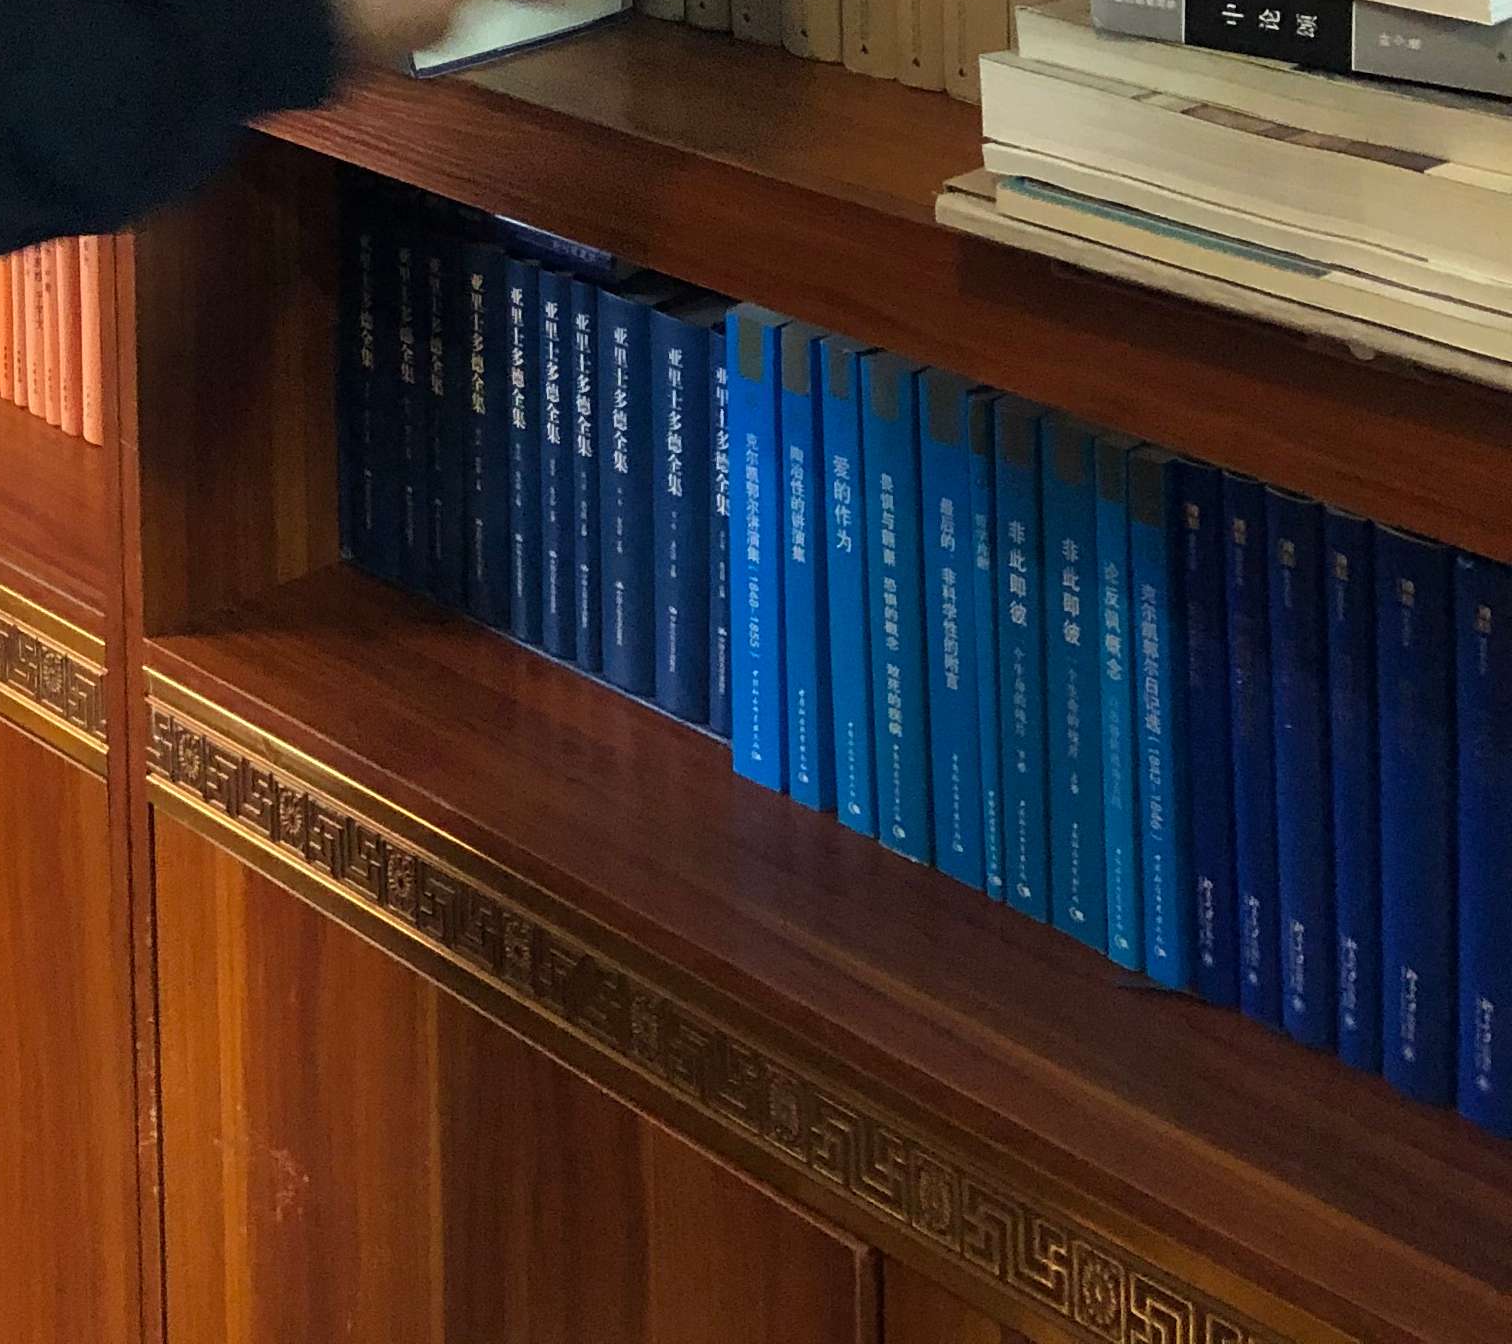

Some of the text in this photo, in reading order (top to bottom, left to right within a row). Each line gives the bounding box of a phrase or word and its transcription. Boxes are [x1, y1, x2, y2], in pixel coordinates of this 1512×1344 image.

[1221, 2, 1319, 40] 中论颂
[470, 273, 486, 415] 亚里士多德全集
[510, 287, 527, 431] 亚里士多德全集
[544, 300, 561, 445] 亚里士多德全集
[575, 313, 593, 457] 亚里士多德全集
[612, 327, 629, 474] 亚里士多德全集
[667, 349, 684, 498] 亚里士多德全集
[715, 367, 730, 517] 亚里士多德全集
[789, 444, 806, 565] 陶冶性的讲演集
[833, 454, 852, 554] 爱的作为
[1007, 519, 1028, 628] 非此即彼
[1061, 537, 1081, 647] 非此即彼
[1104, 561, 1123, 682] 论反讽概念
